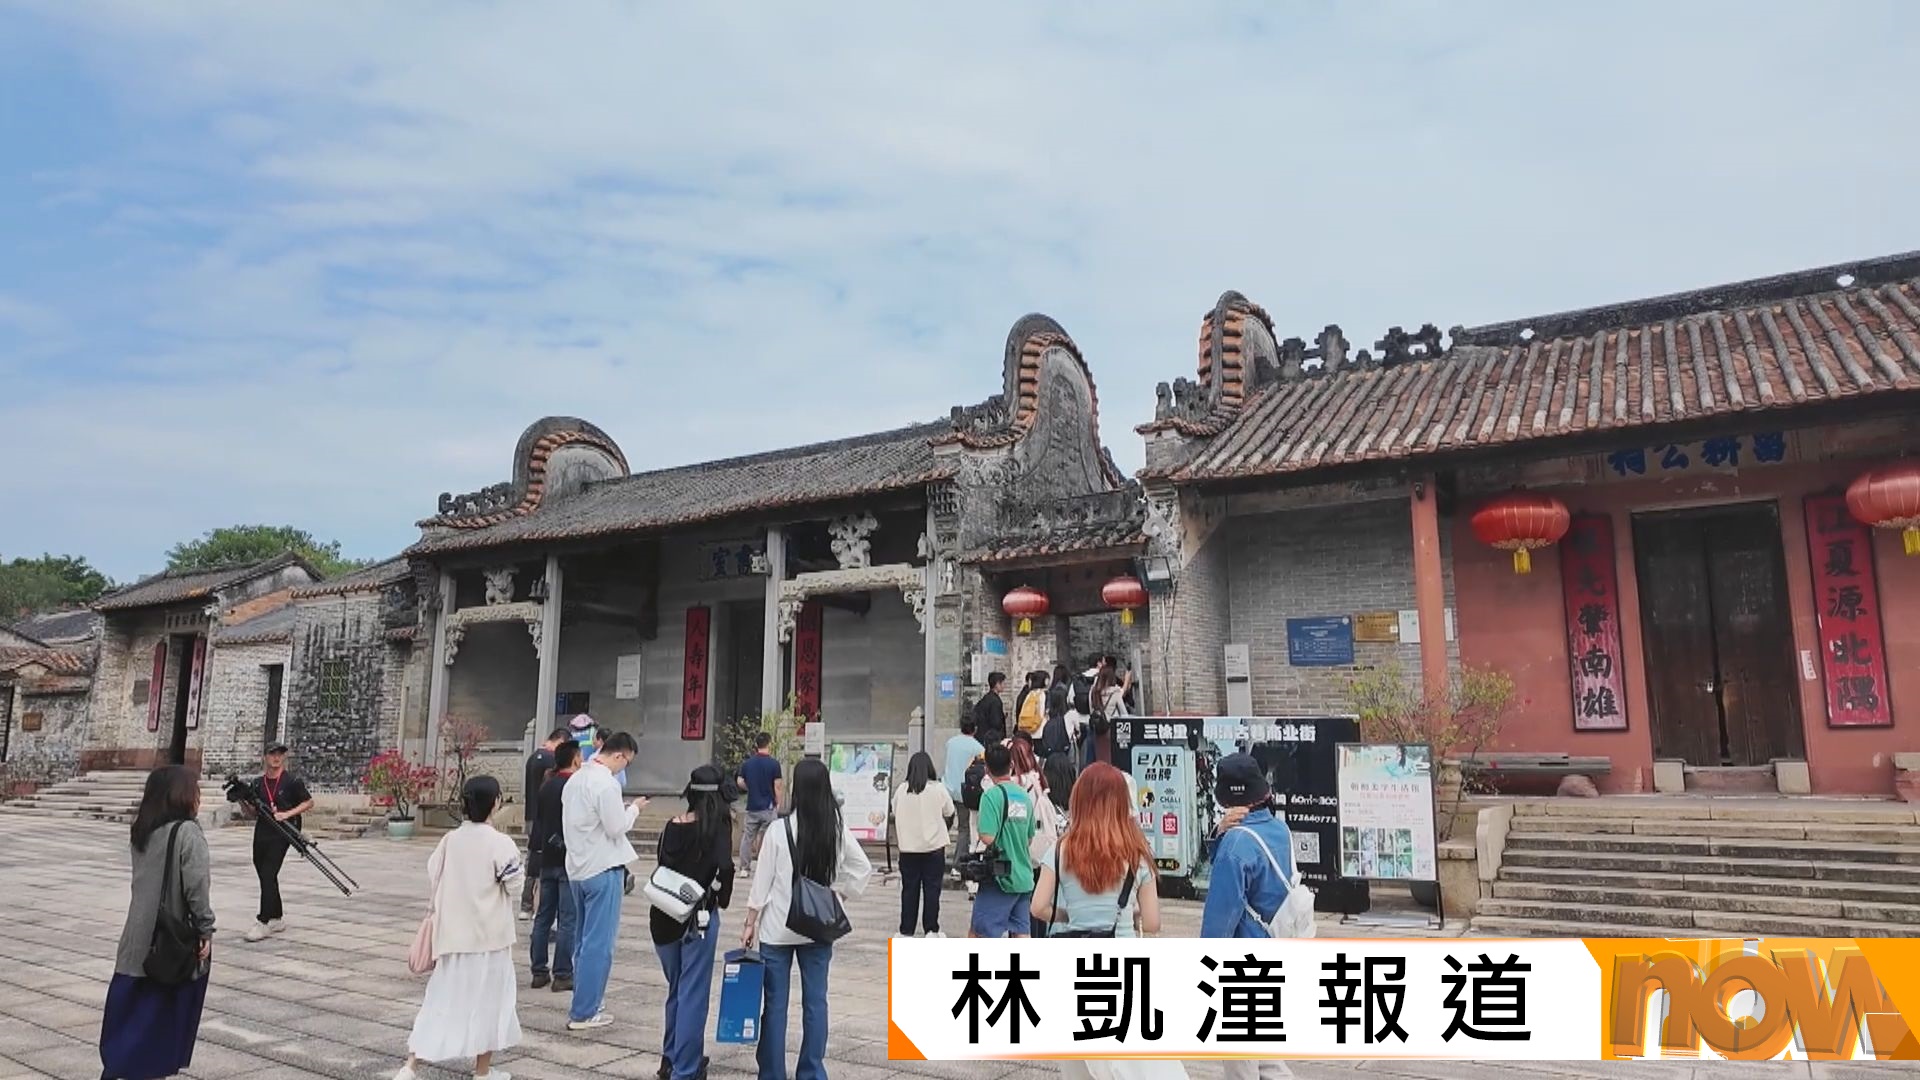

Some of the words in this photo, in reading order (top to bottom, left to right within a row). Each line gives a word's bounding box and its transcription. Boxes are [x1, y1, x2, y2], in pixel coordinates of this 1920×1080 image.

[1569, 525, 1619, 719] 肇南雄
[1137, 752, 1178, 767] 已入驻
[1144, 768, 1172, 781] 品牌
